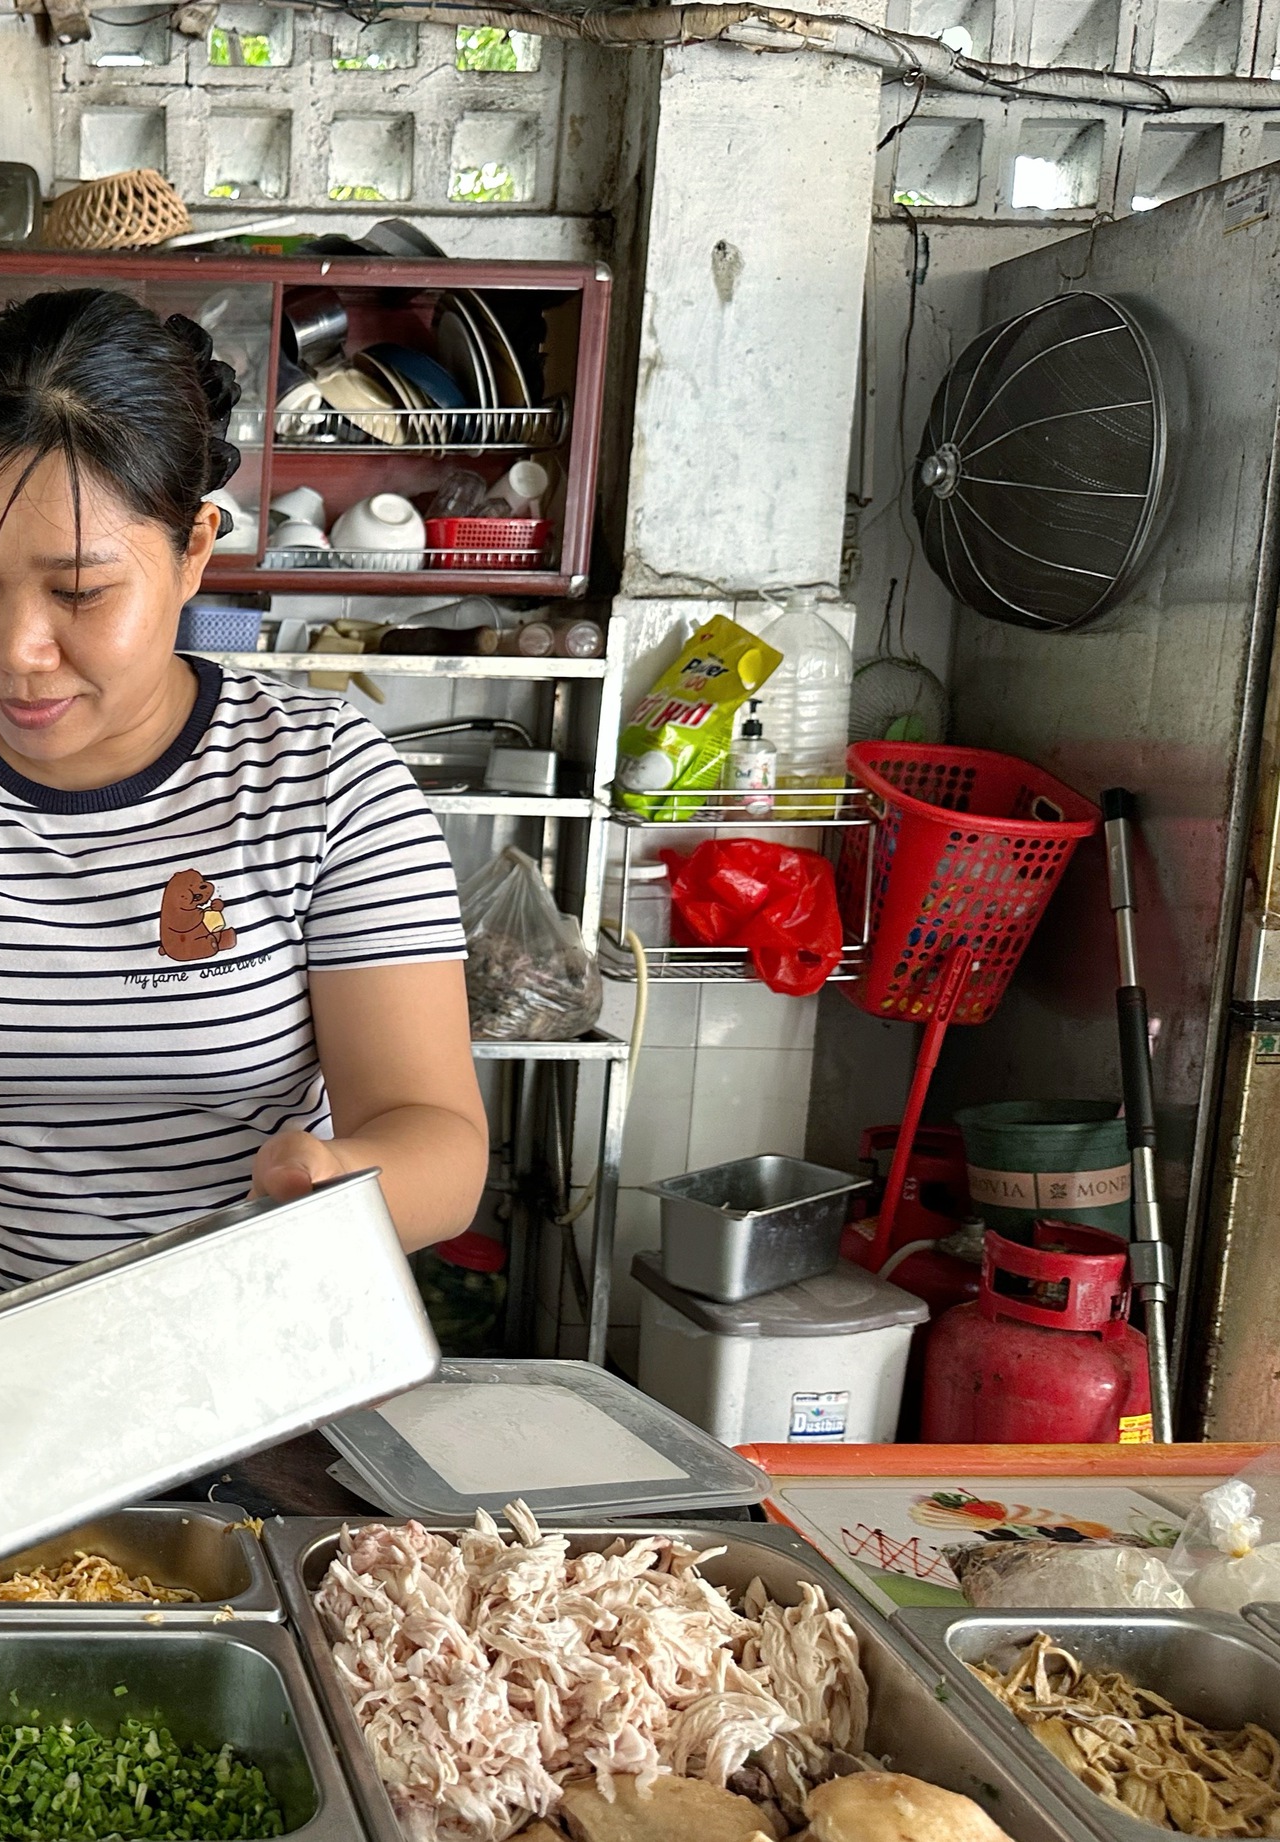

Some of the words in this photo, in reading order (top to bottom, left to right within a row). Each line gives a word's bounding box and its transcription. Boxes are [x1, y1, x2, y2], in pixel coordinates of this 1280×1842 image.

[123, 974, 150, 990] My
[152, 971, 189, 988] fame
[792, 1412, 844, 1433] Dustbin
